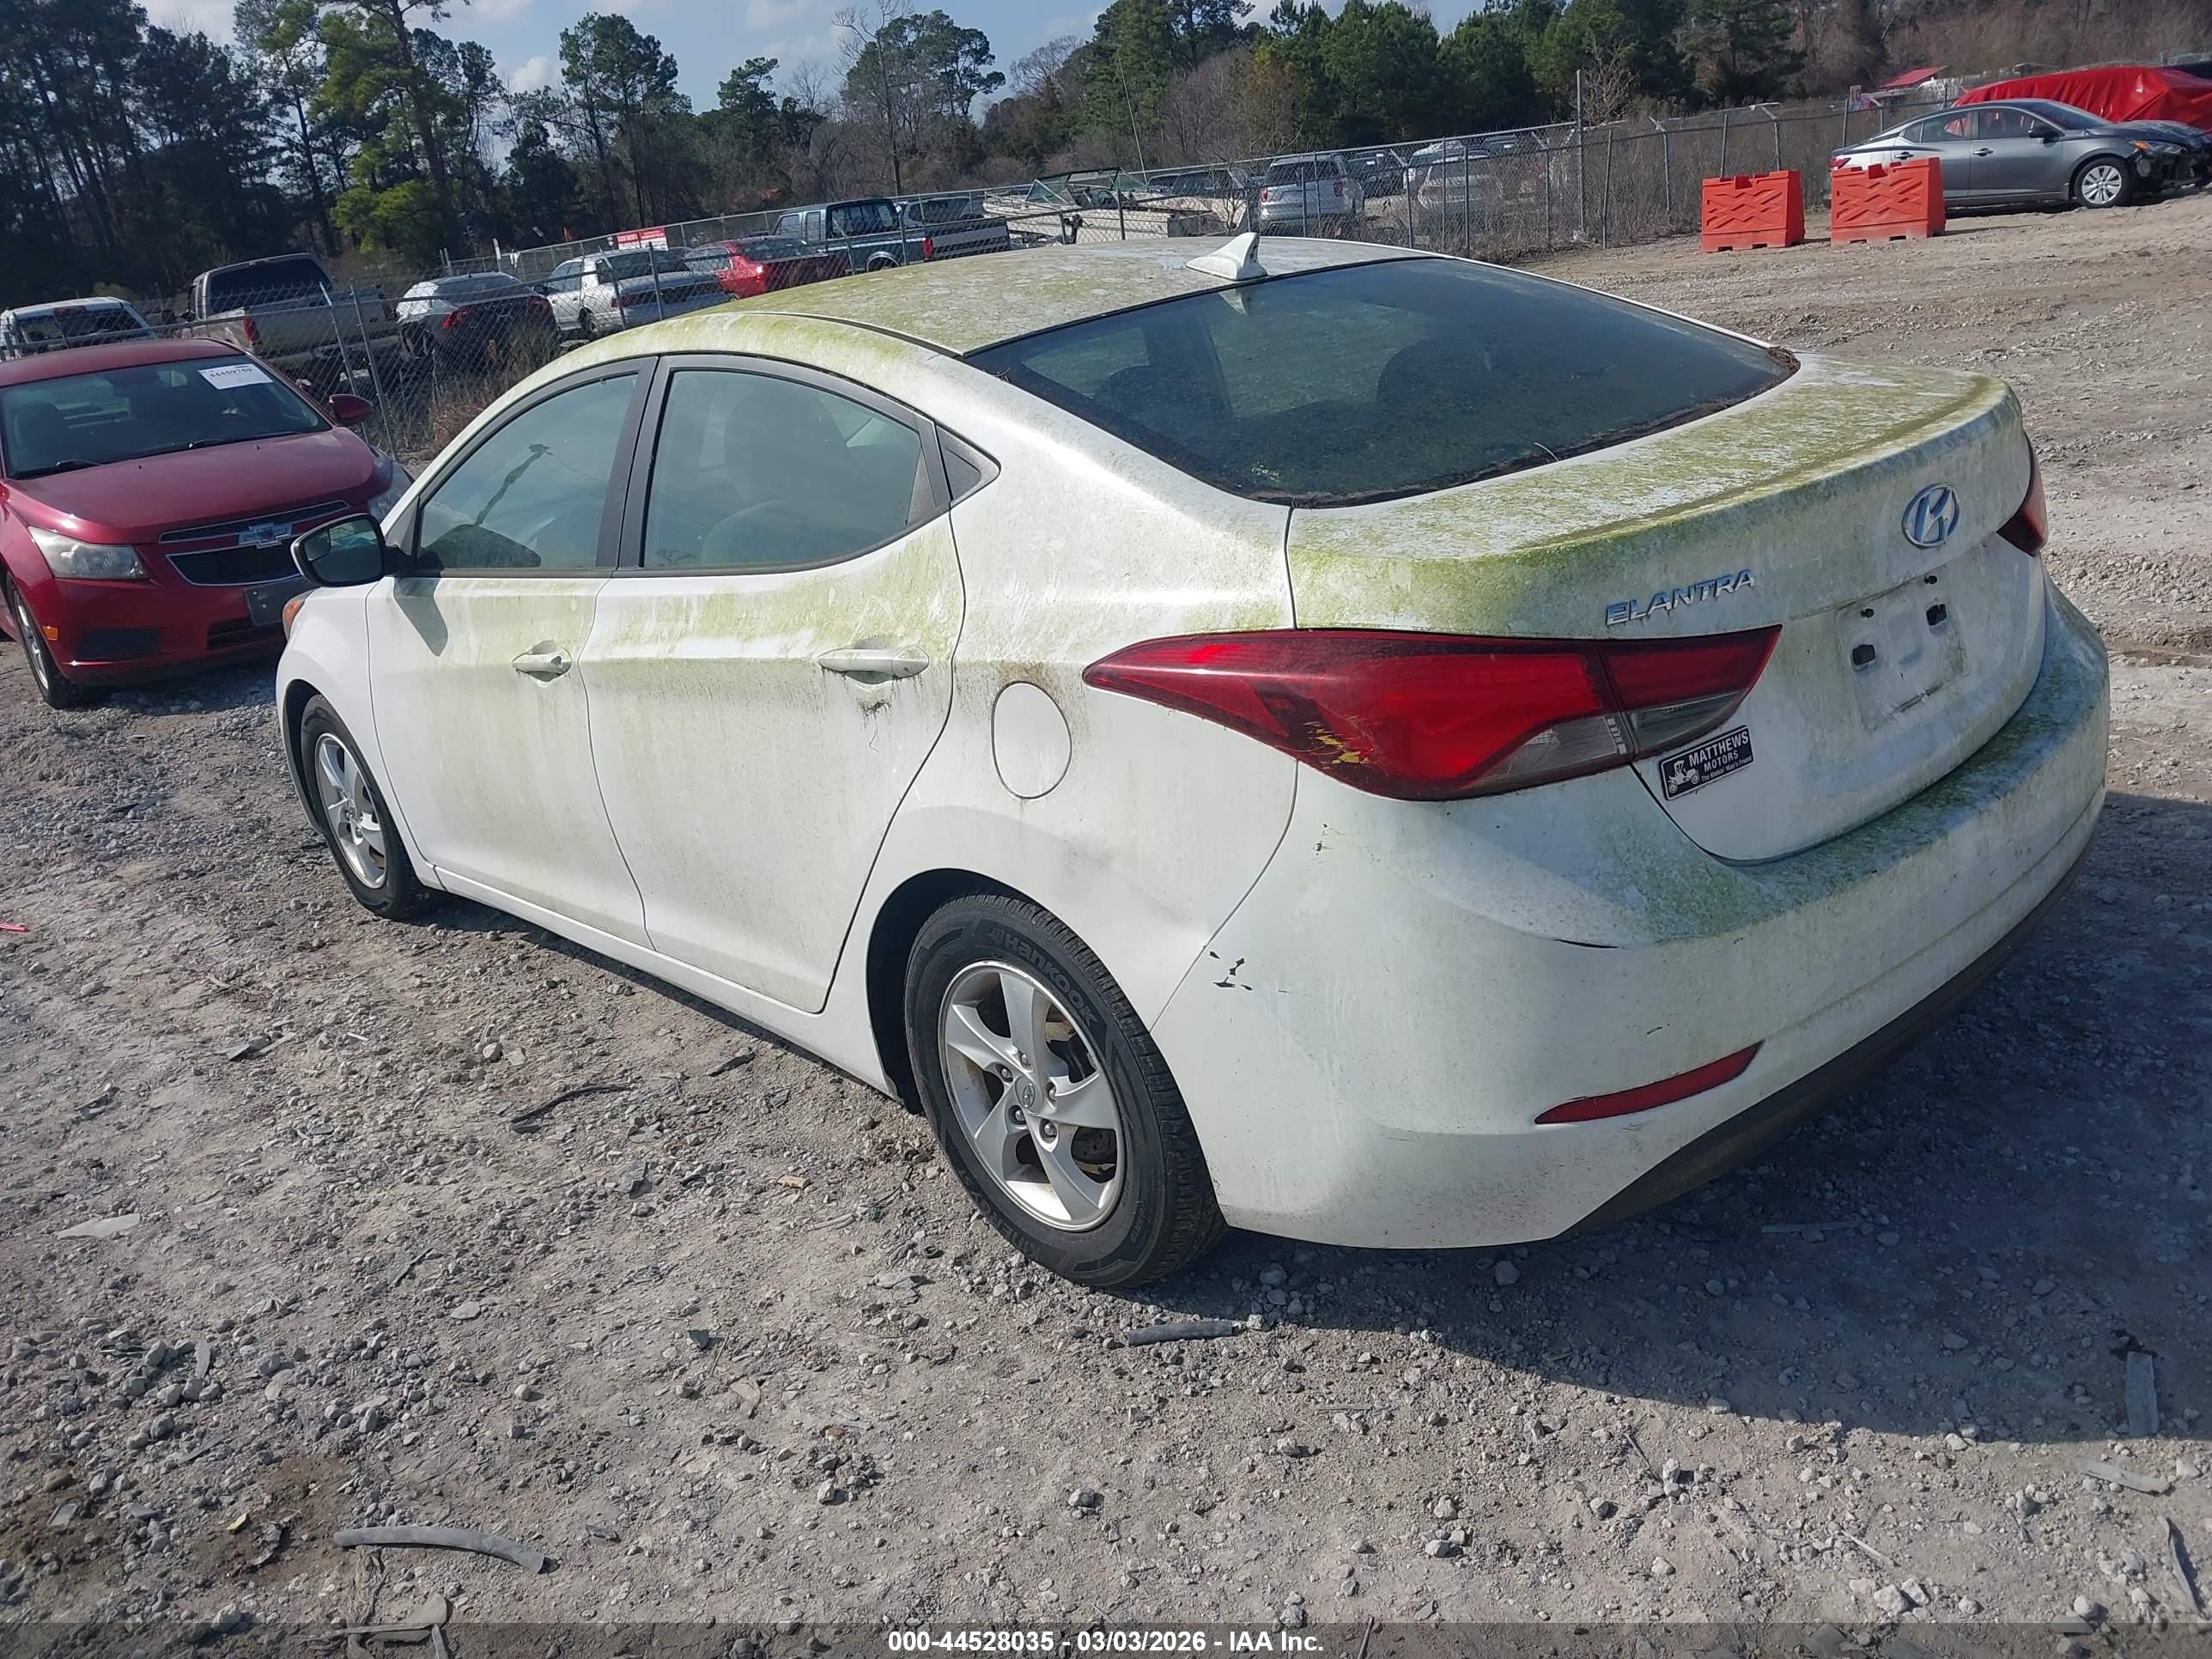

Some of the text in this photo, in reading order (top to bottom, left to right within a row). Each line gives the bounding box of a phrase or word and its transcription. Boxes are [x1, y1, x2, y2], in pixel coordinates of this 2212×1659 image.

[1606, 568, 1756, 626] ELANTRA
[1688, 731, 1749, 768] MATTHEWS
[1704, 750, 1739, 773] MOTORS
